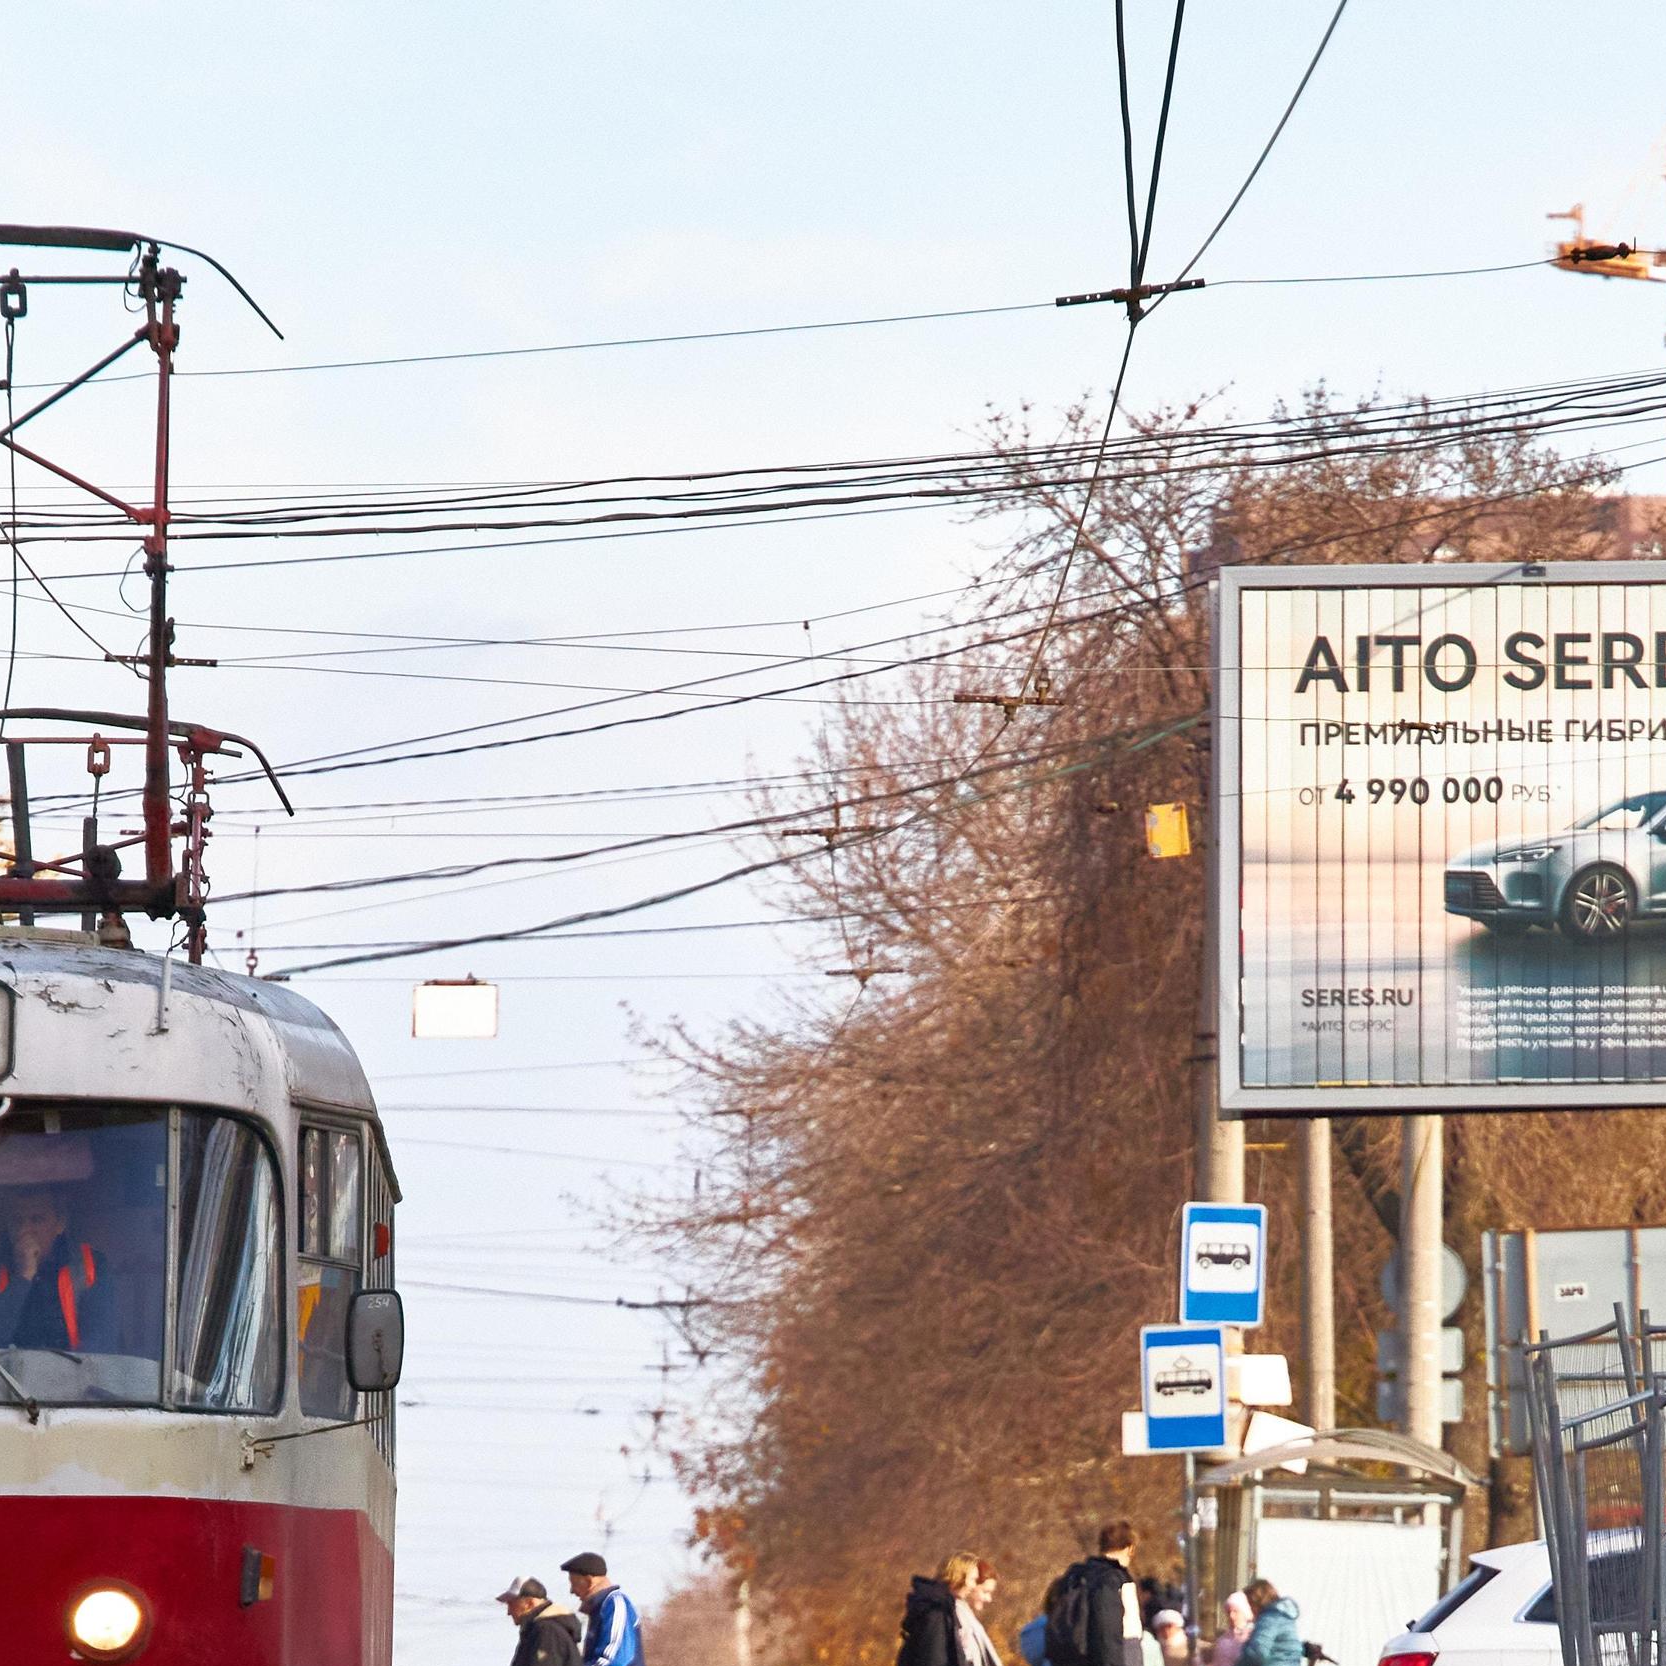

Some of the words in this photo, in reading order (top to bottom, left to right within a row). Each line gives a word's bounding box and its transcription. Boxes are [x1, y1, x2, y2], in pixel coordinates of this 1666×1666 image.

[1294, 632, 1478, 694] AITO
[1299, 718, 1554, 746] ПРЕМИАЛЬНЫЕ
[1334, 778, 1355, 804] 4
[1366, 777, 1430, 805] 990
[1442, 776, 1503, 804] 000
[1301, 988, 1413, 1008] SERES.RU
